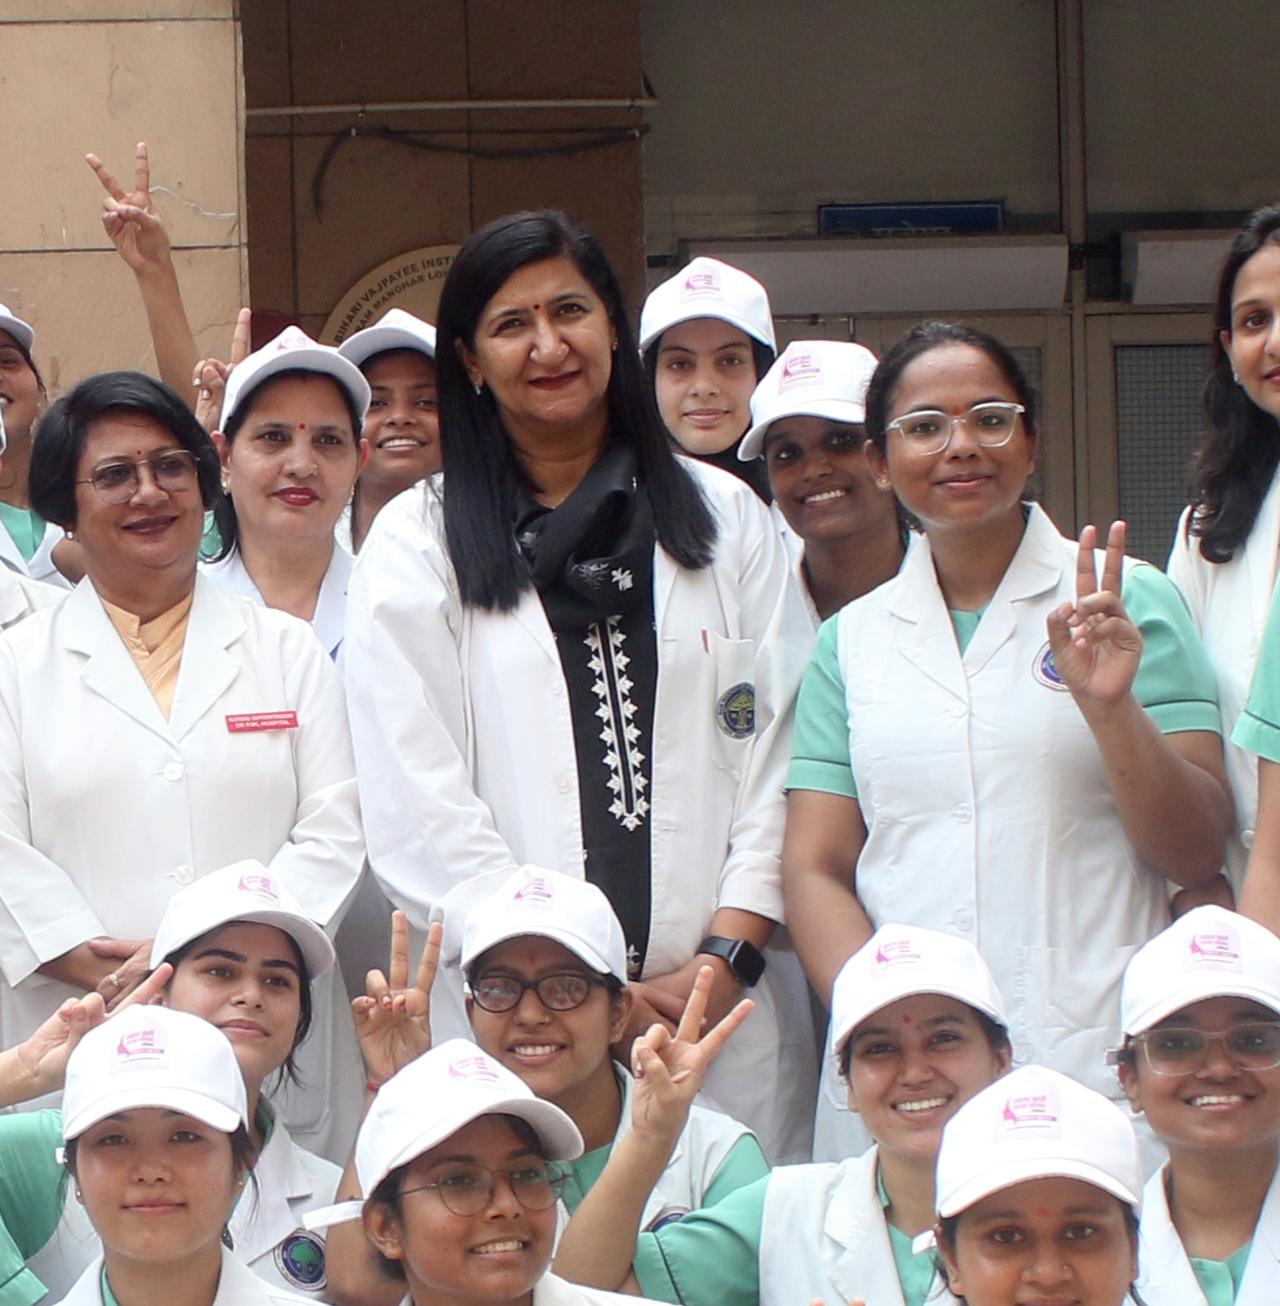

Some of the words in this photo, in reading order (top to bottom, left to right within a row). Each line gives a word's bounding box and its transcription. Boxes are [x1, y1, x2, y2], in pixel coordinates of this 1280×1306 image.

[334, 300, 363, 344] BIHARI
[361, 261, 420, 303] VAJPAYEE
[372, 275, 426, 309] MANOHAR
